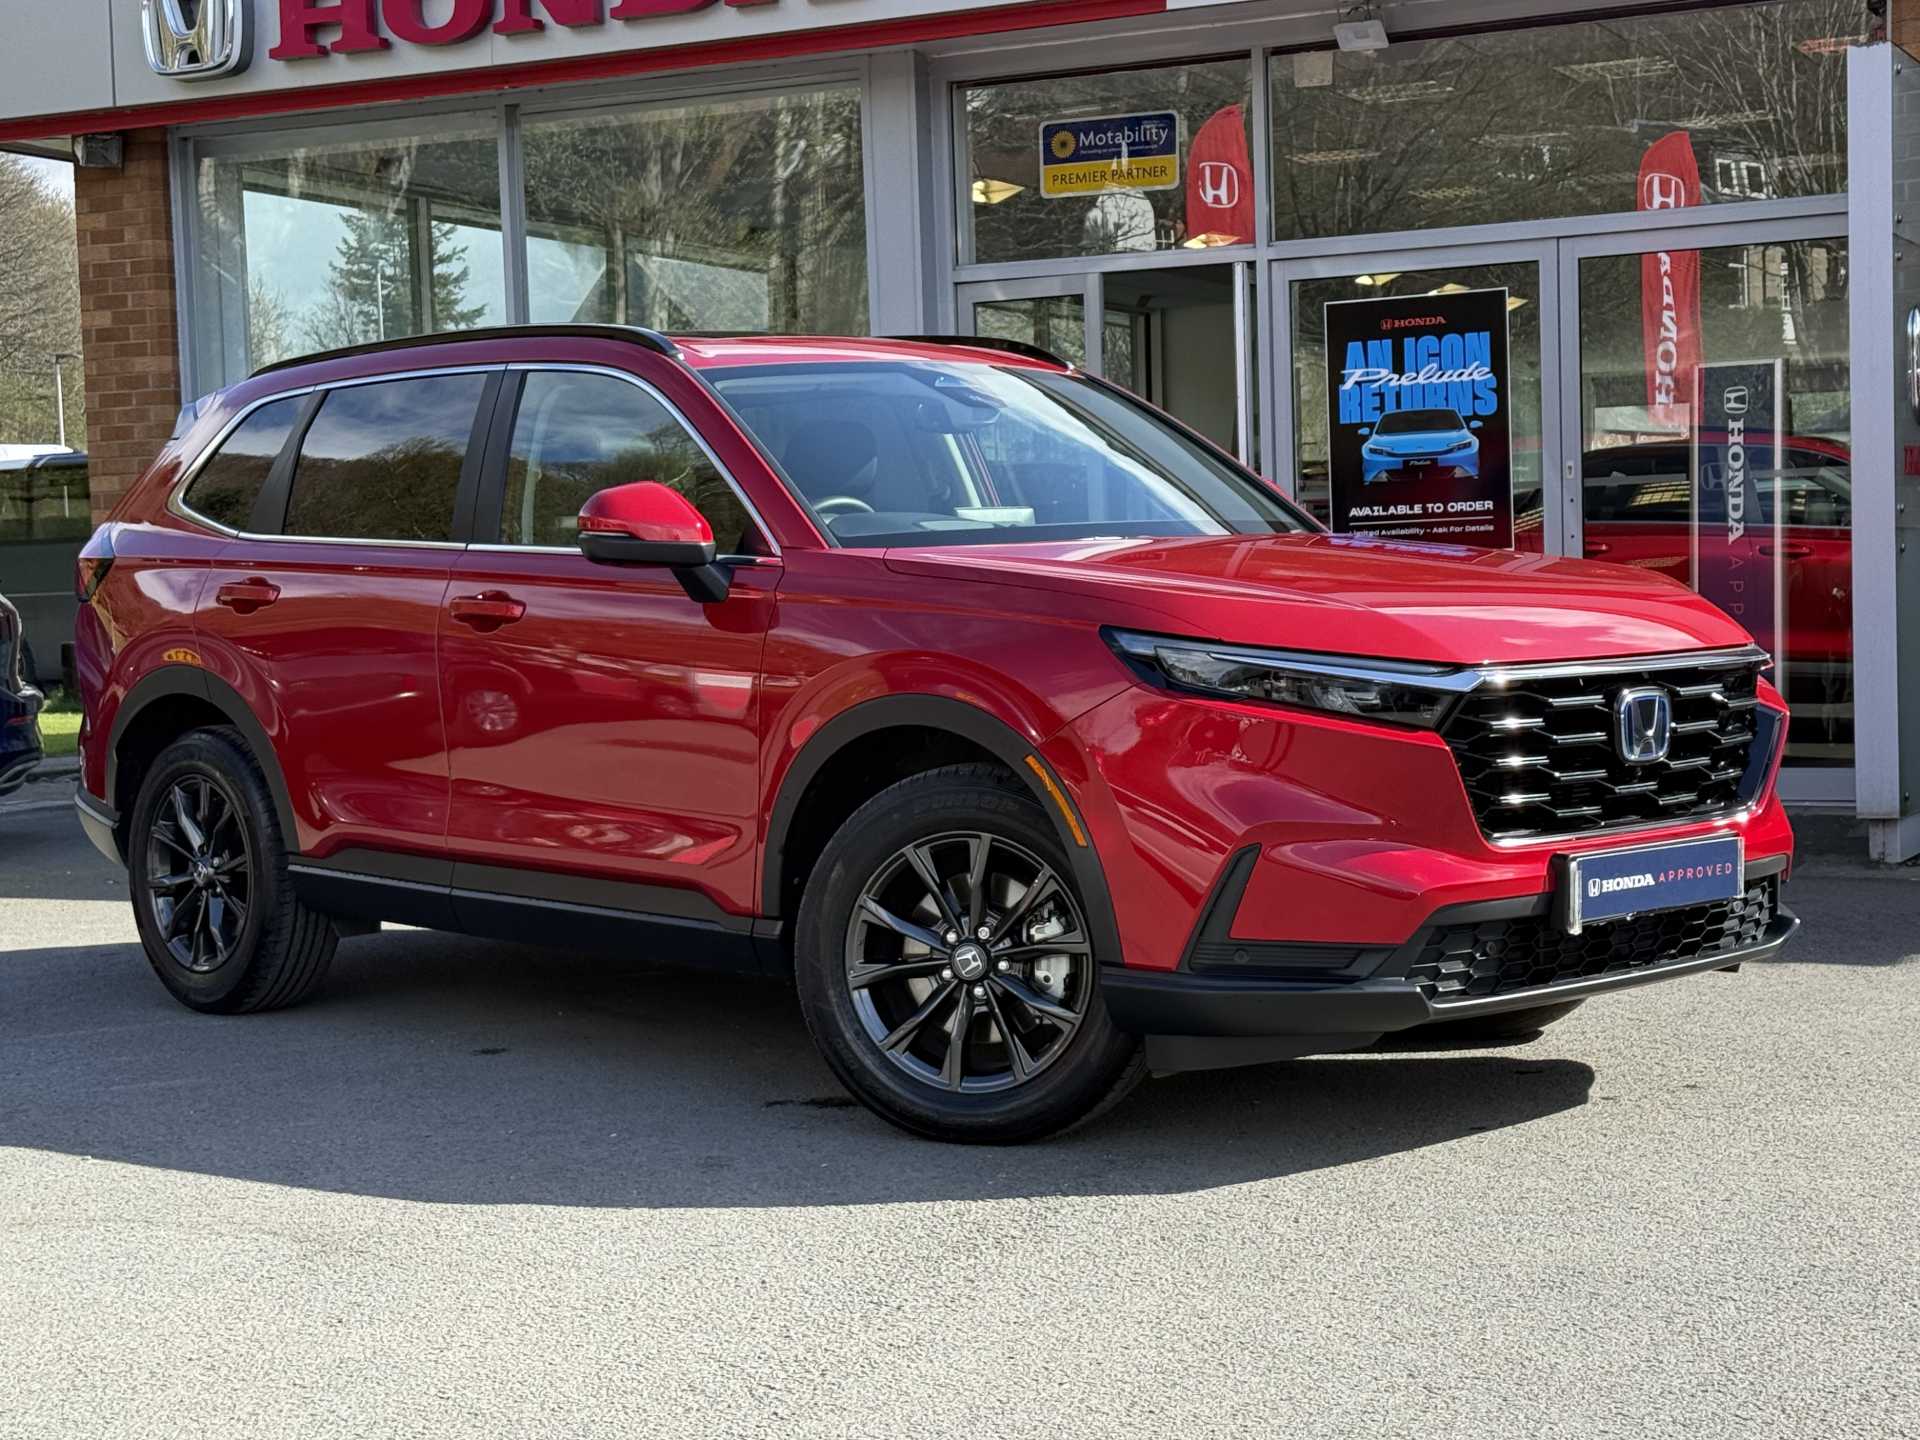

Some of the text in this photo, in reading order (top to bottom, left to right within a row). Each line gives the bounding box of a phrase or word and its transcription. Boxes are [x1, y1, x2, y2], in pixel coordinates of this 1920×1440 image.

[1080, 126, 1168, 146] Motability
[1052, 166, 1168, 186] PREMIER PARTNER
[1393, 316, 1447, 328] HONDA
[1344, 331, 1491, 383] AN ICON
[1341, 361, 1493, 390] Prelude
[1339, 376, 1498, 424] RETURNS
[1728, 418, 1744, 546] HONDA
[1349, 500, 1494, 518] AVAILABLE TO ORDER
[1381, 527, 1425, 537] Availability
[1432, 526, 1448, 534] Ask
[1449, 525, 1464, 533] For
[1464, 523, 1495, 532] Details
[1601, 863, 1732, 892] HONDA APPROVED
